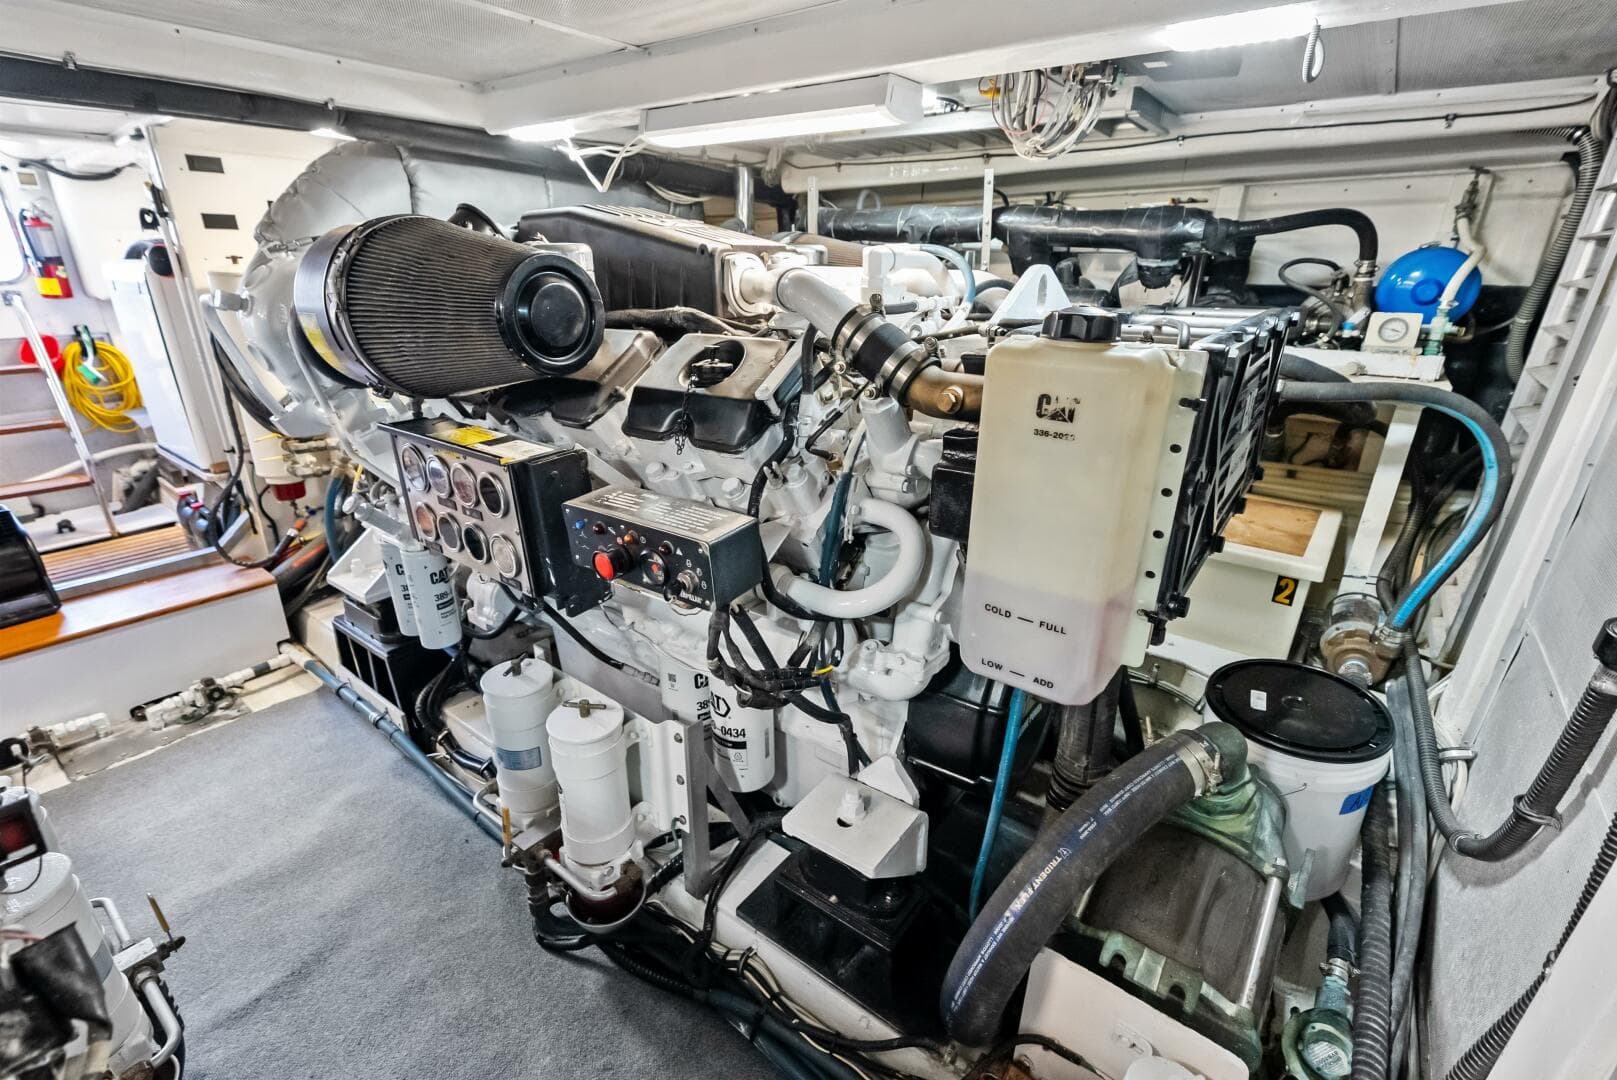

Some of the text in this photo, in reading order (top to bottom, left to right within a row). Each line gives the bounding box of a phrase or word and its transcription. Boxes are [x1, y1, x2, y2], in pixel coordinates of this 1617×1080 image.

[429, 566, 450, 584] CAT
[1274, 578, 1296, 604] 2
[984, 603, 1067, 635] COLD FULL
[981, 657, 1054, 689] LOW ADD
